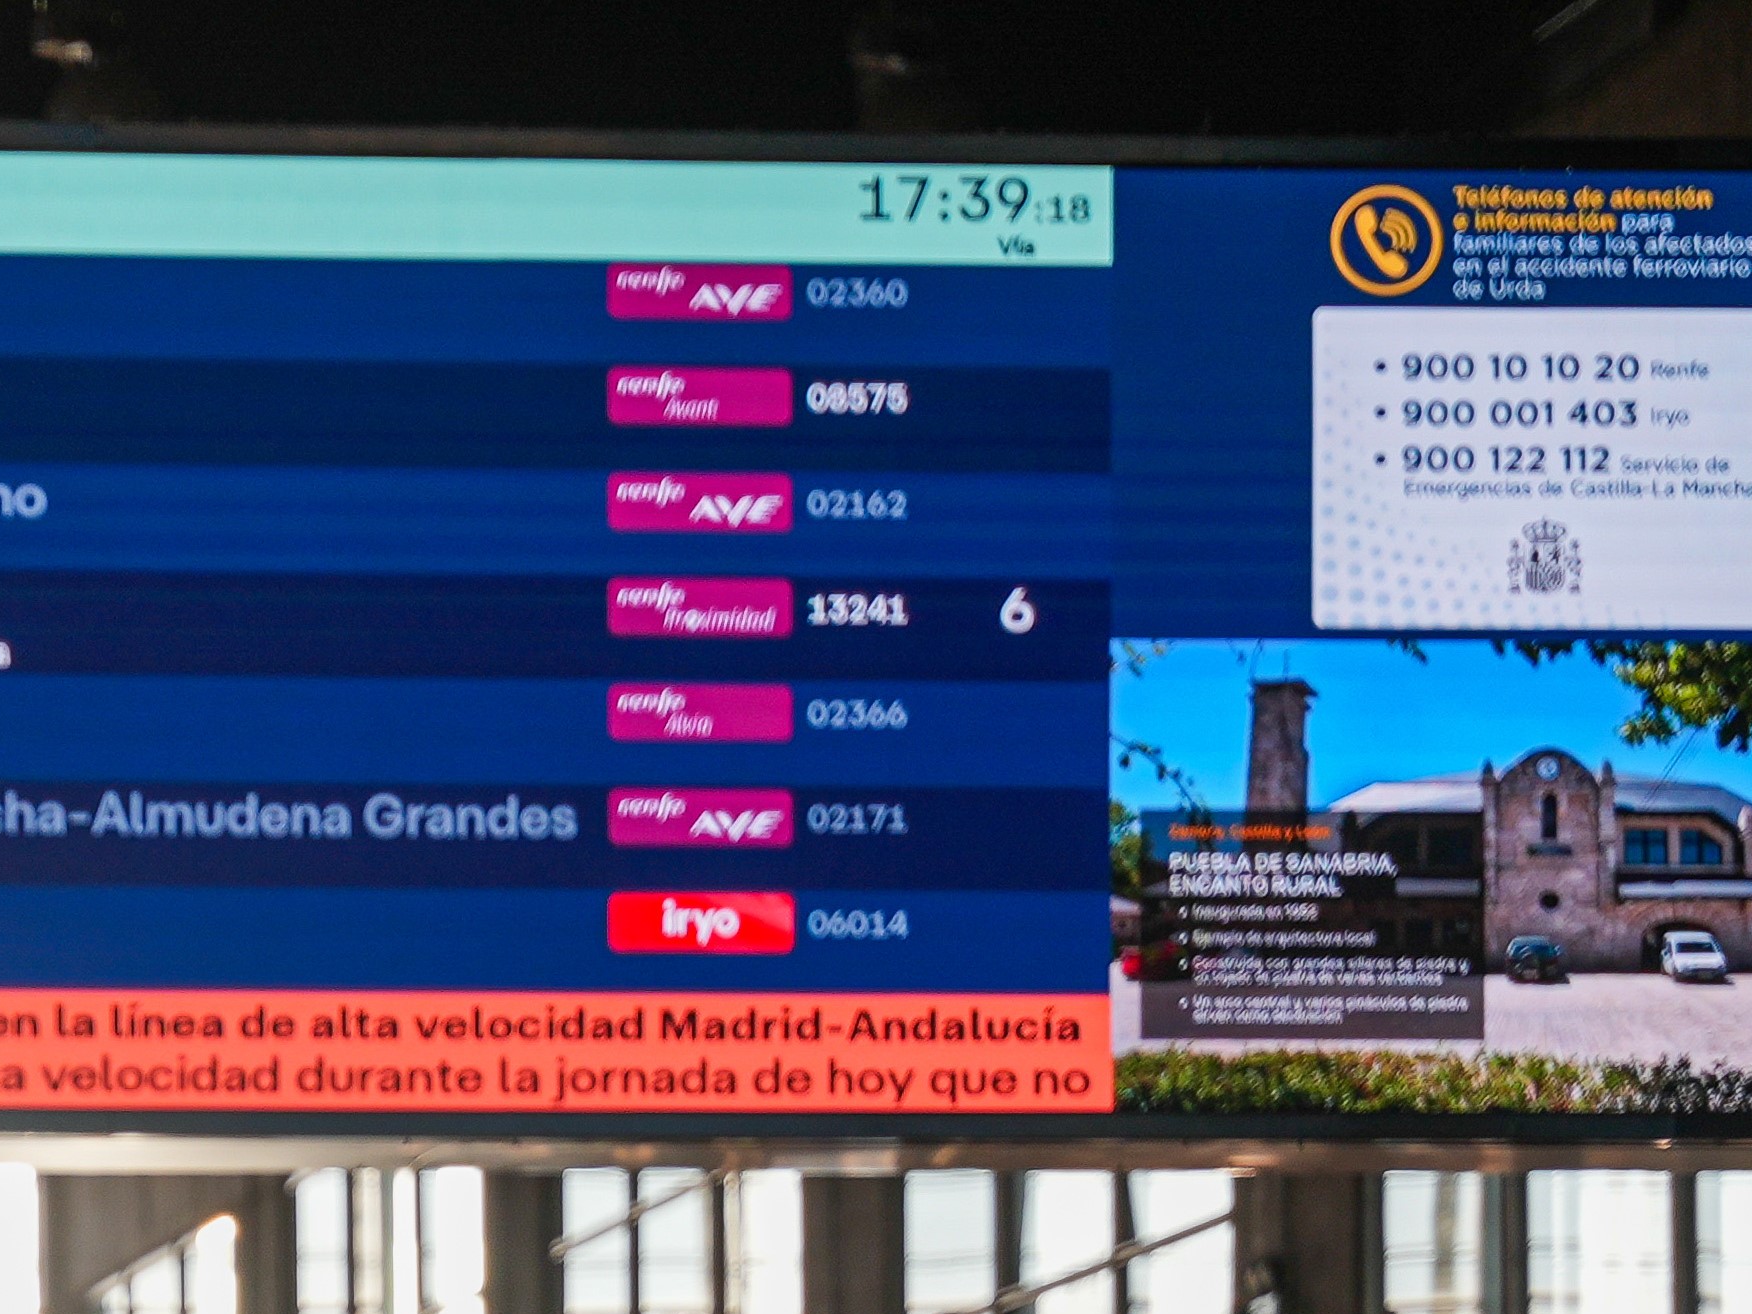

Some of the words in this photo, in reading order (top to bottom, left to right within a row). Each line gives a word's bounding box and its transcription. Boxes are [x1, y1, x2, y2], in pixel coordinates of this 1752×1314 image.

[1453, 184, 1568, 209] Teléfonos
[1573, 186, 1605, 209] de
[1610, 184, 1714, 210] atención
[1453, 213, 1469, 232] e
[1475, 209, 1617, 233] información
[1621, 213, 1675, 235] para
[1453, 232, 1565, 255] familiares
[1569, 232, 1601, 255] de
[1606, 232, 1639, 255] los
[1453, 257, 1482, 277] en
[1487, 257, 1509, 277] el
[1514, 256, 1627, 277] accidente
[1633, 254, 1752, 278] ferroviario
[1453, 276, 1484, 300] de
[1489, 277, 1546, 300] Urda
[1401, 354, 1474, 380] 900
[1488, 354, 1527, 380] 10
[1542, 354, 1579, 380] 10
[1593, 354, 1640, 380] 20
[1650, 360, 1709, 378] Renfe
[1401, 399, 1474, 427] 900
[1489, 399, 1553, 427] 001
[1568, 399, 1637, 427] 403
[1650, 409, 1690, 430] Iryo
[1401, 446, 1474, 474] 900
[1489, 446, 1544, 473] 122
[1560, 446, 1609, 472] 112
[1621, 455, 1698, 473] Servicio
[1705, 458, 1730, 472] de
[1404, 480, 1531, 501] Emergencias
[1538, 481, 1562, 496] de
[808, 594, 908, 627] 13241
[1000, 588, 1036, 634] 6
[808, 700, 908, 730] 02366
[1169, 852, 1251, 874] PUEBLA
[1254, 854, 1283, 873] DE
[1169, 875, 1269, 897] ENCANTO
[1272, 876, 1344, 897] RURAL
[662, 898, 739, 945] iryo
[808, 910, 909, 938] 06014
[54, 1005, 93, 1038] la
[110, 1003, 222, 1039] línea
[241, 1006, 291, 1039] de
[311, 1008, 397, 1039] alta
[416, 1006, 645, 1042] velocidad
[661, 1005, 1081, 1044] Madrid-Andalucía
